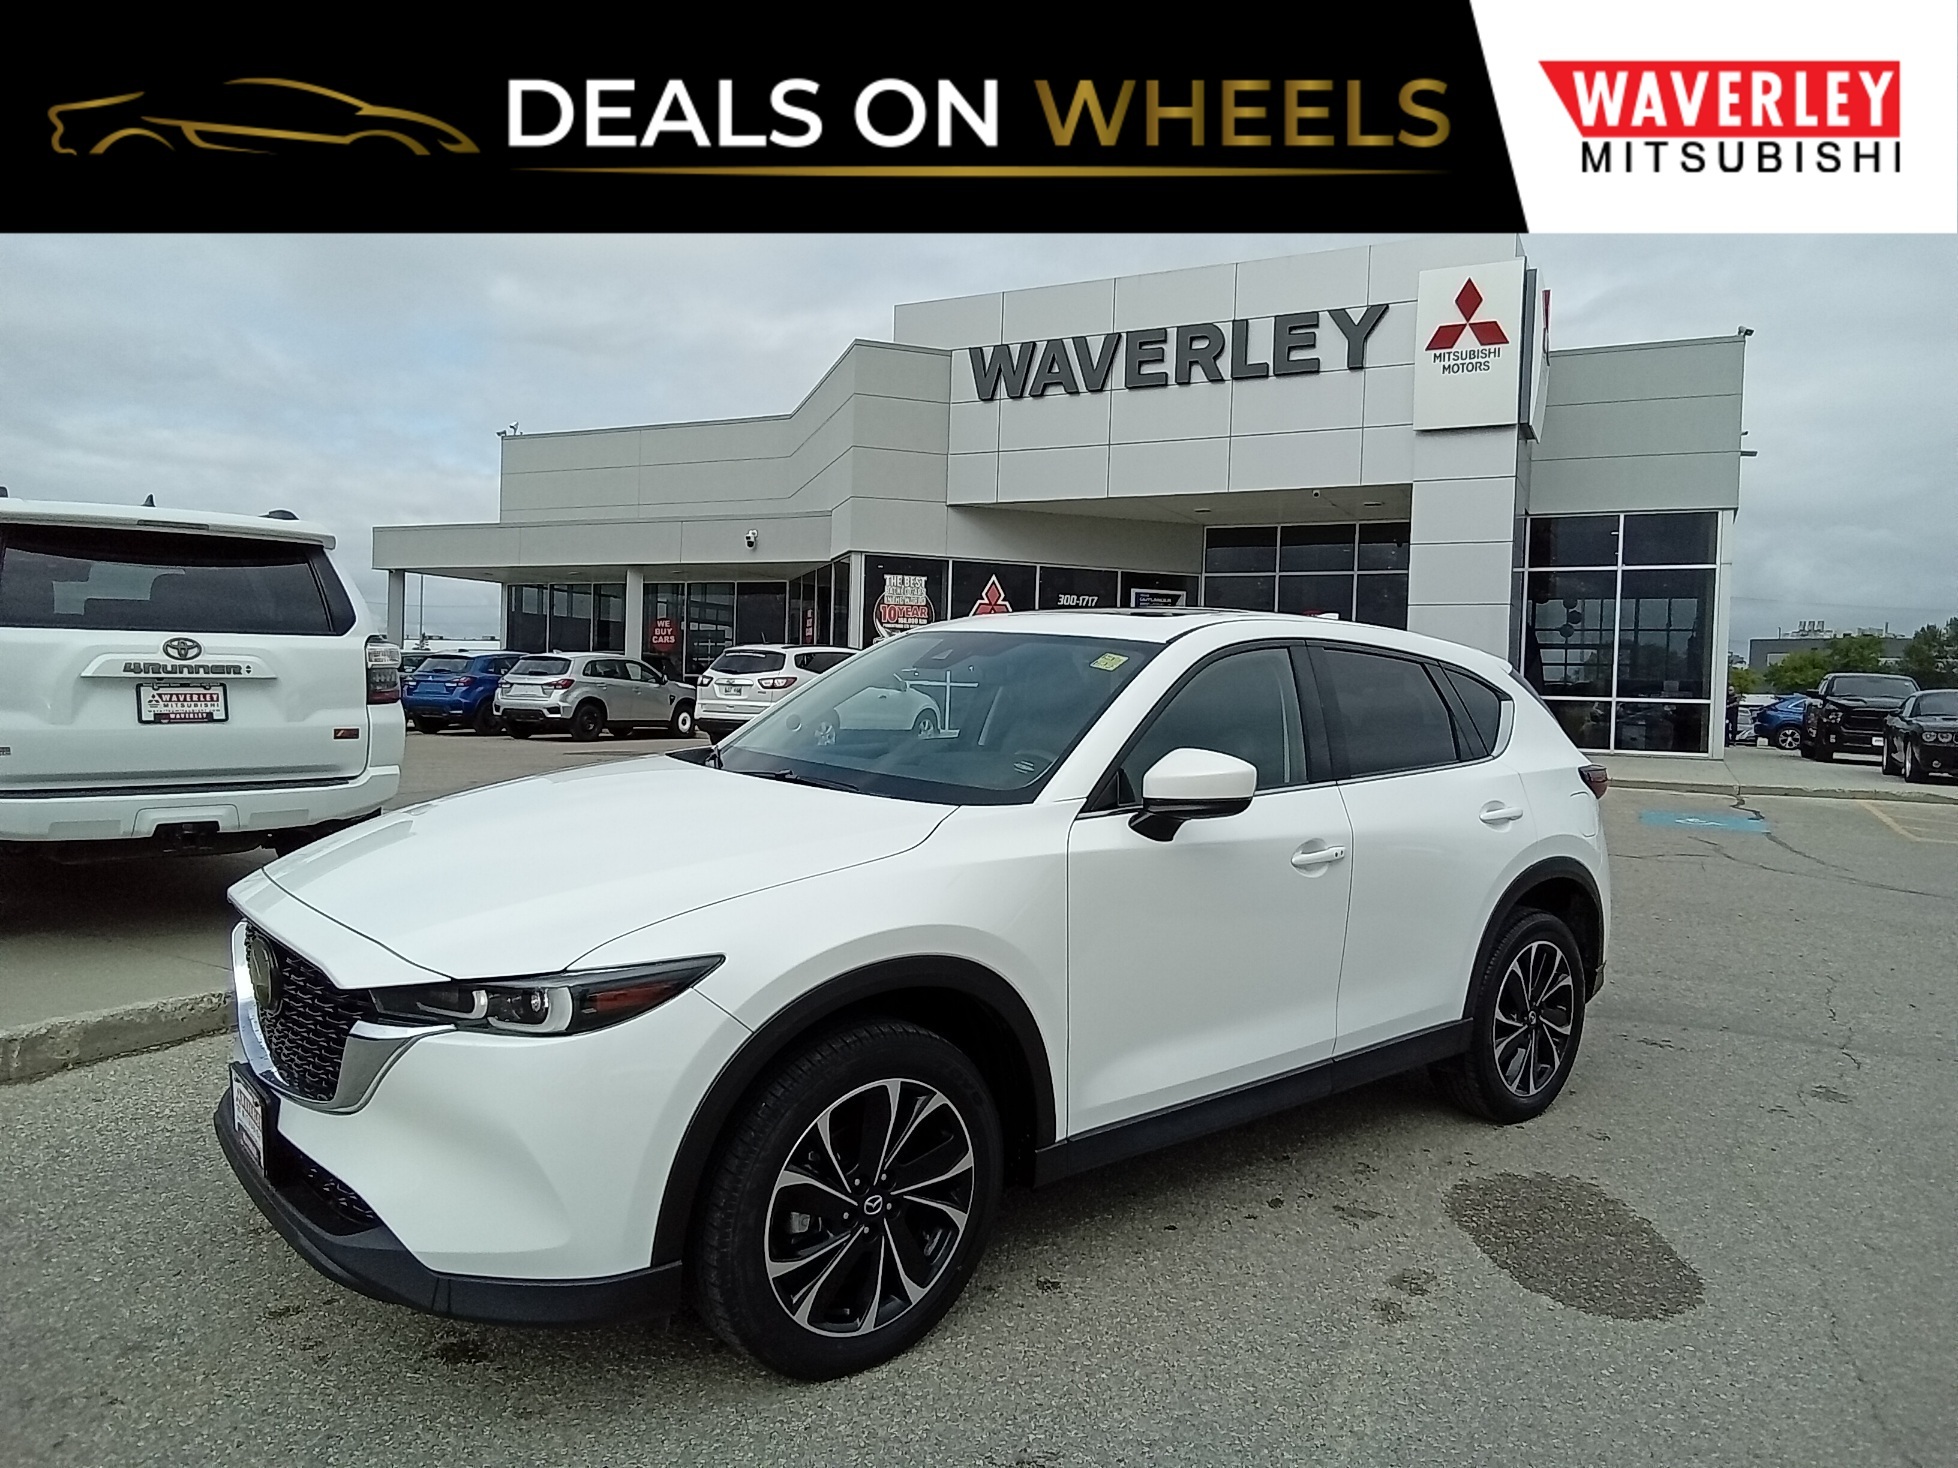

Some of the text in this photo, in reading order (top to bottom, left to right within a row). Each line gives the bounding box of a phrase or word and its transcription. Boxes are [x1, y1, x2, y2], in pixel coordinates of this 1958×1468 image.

[968, 304, 1390, 401] WAVERLEY
[1433, 347, 1501, 363] MITSUBISHI
[1442, 361, 1491, 375] MOTORS
[884, 574, 927, 588] THE BEST
[1057, 594, 1098, 607] 300-1717
[880, 604, 928, 623] 10 YEAR
[657, 620, 671, 628] WE
[652, 635, 676, 644] CARS
[161, 694, 219, 702] WAVERLEY
